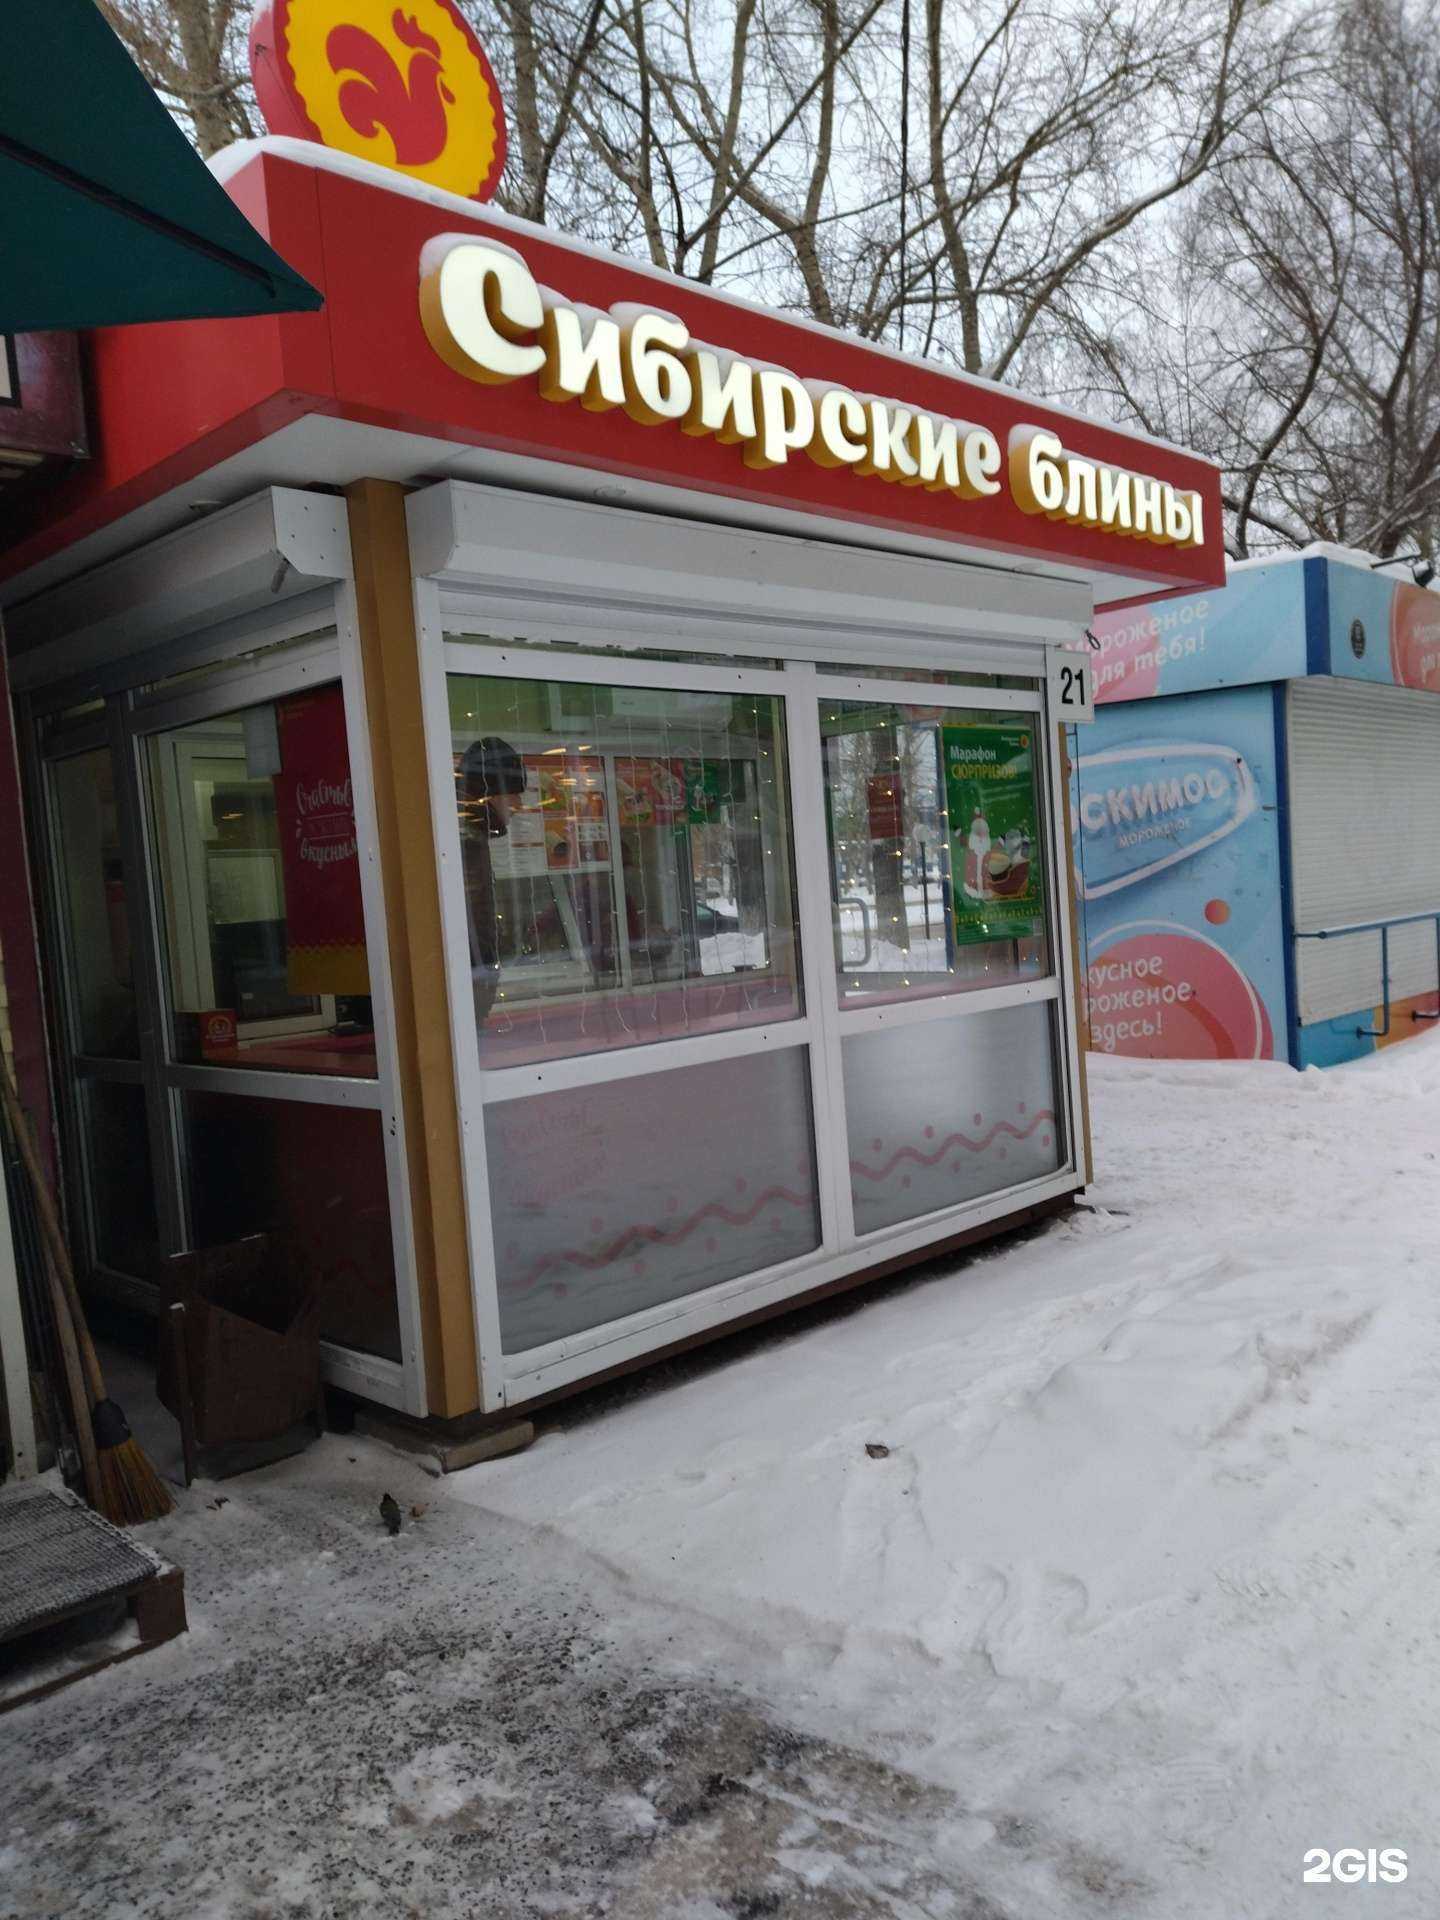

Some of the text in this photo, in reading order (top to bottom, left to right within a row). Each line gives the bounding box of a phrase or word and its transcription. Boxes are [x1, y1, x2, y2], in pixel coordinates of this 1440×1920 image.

[422, 240, 1205, 548] Сибирские блины
[1134, 627, 1206, 673] тебя!
[1061, 666, 1085, 706] 21
[949, 744, 997, 764] Марафон
[1090, 1010, 1163, 1053] здесь!
